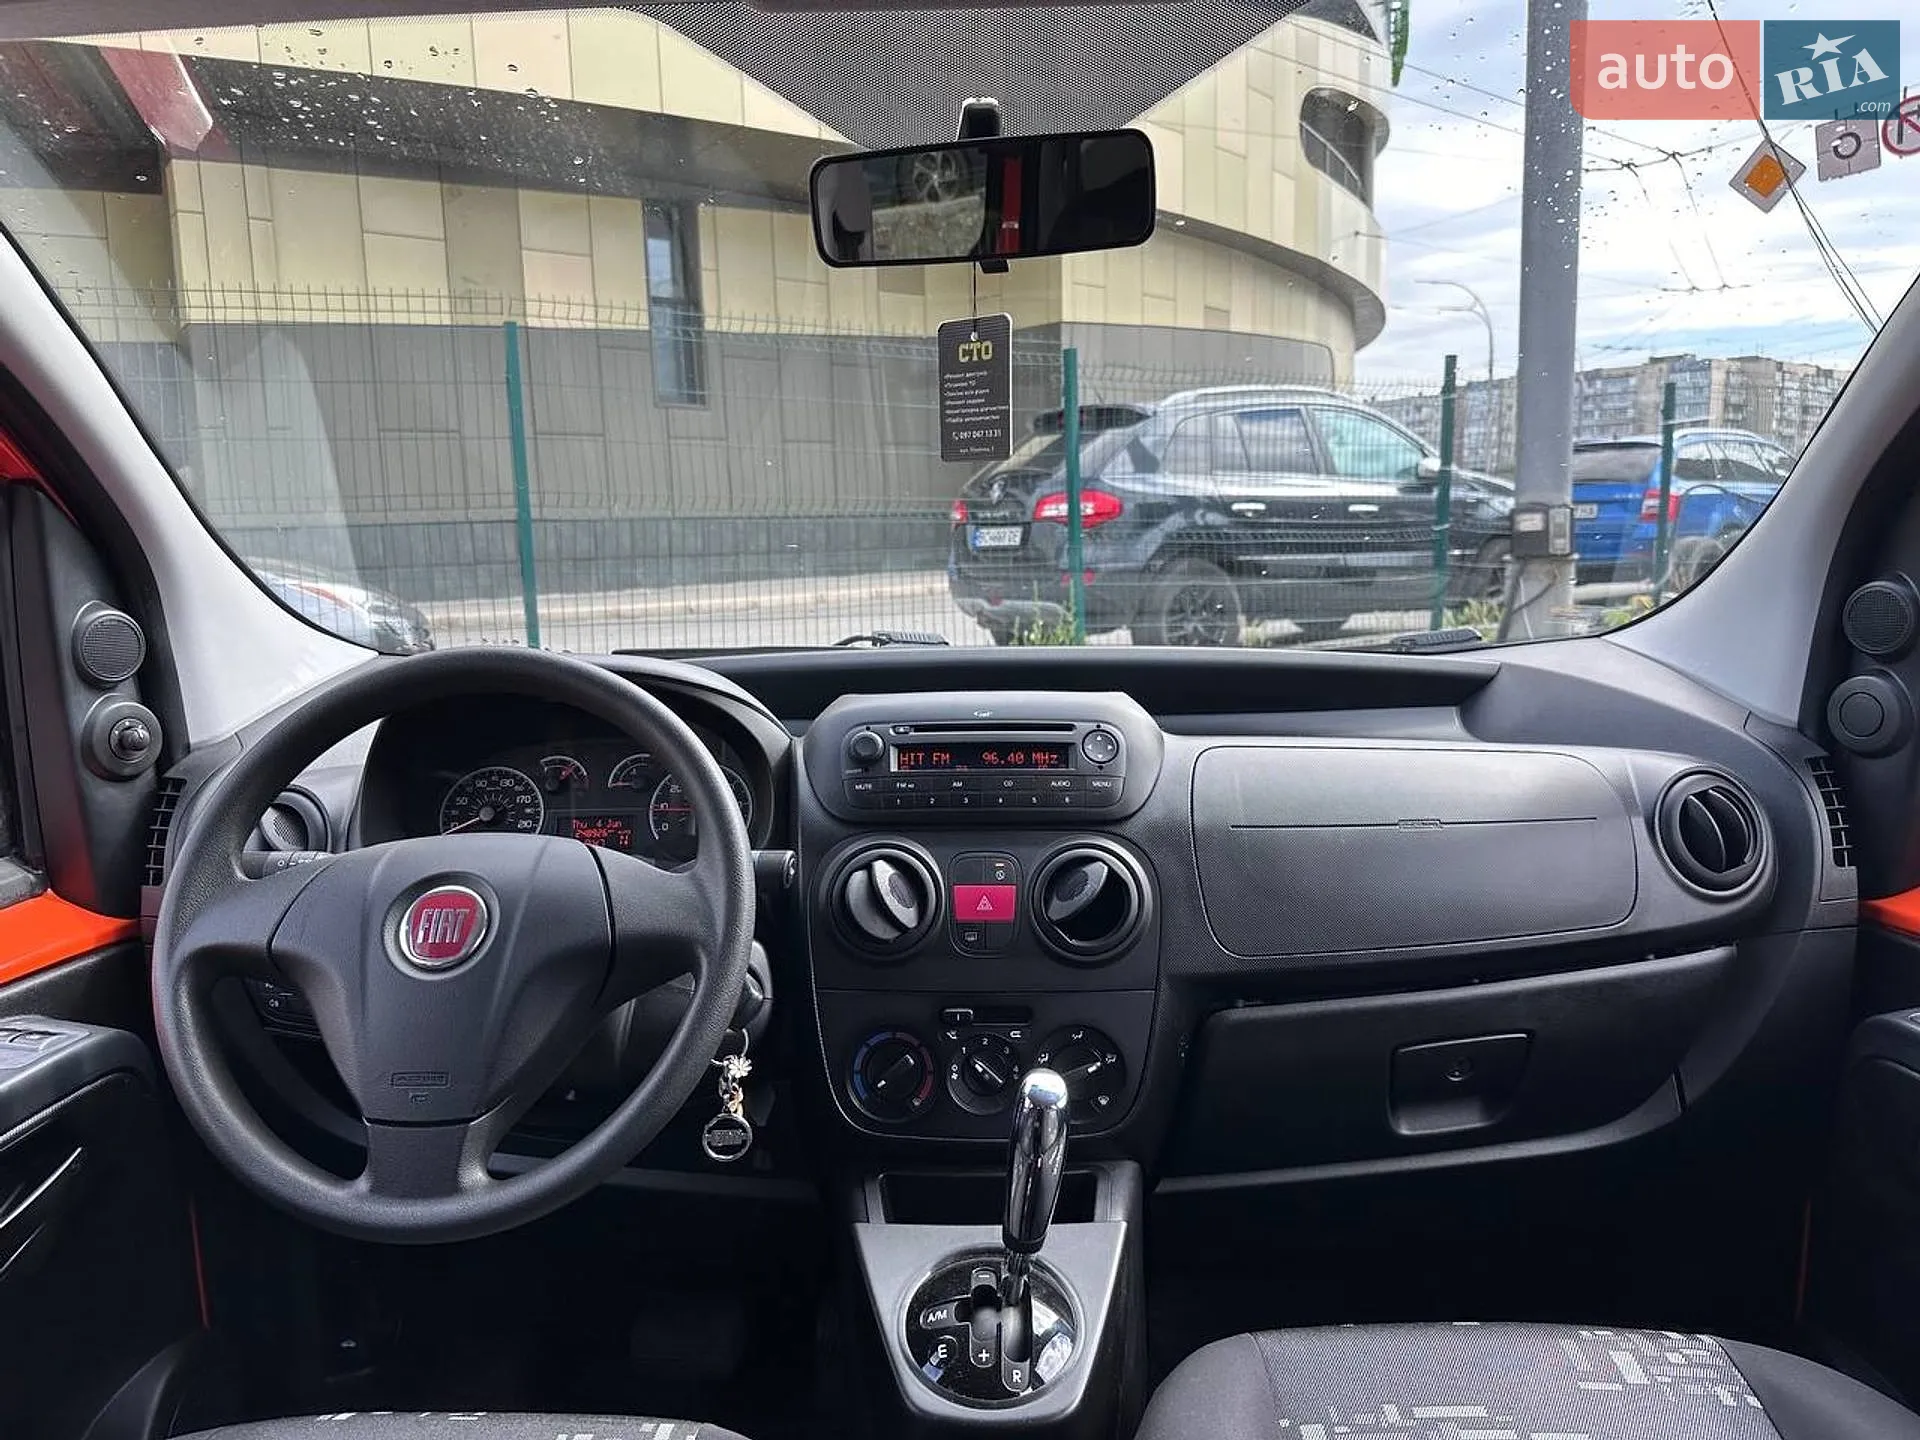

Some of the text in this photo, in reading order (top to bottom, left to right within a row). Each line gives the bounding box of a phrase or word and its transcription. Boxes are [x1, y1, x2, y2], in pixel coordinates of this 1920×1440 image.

[900, 752, 1058, 765] HIT FM 96.40 MHz
[475, 779, 487, 788] 90
[499, 778, 514, 787] 130
[952, 780, 963, 788] AM
[1003, 779, 1014, 787] CD
[1051, 779, 1071, 787] AUDIO
[1092, 780, 1112, 788] MENU
[455, 796, 468, 806] 50
[516, 795, 532, 804] 170
[929, 797, 935, 805] 2
[661, 822, 669, 831] 0
[416, 907, 470, 944] FIAT
[982, 1037, 988, 1046] 2
[961, 1046, 966, 1055] 1
[1003, 1046, 1010, 1055] 3
[926, 1309, 948, 1324] A/M
[1012, 1369, 1022, 1383] R
